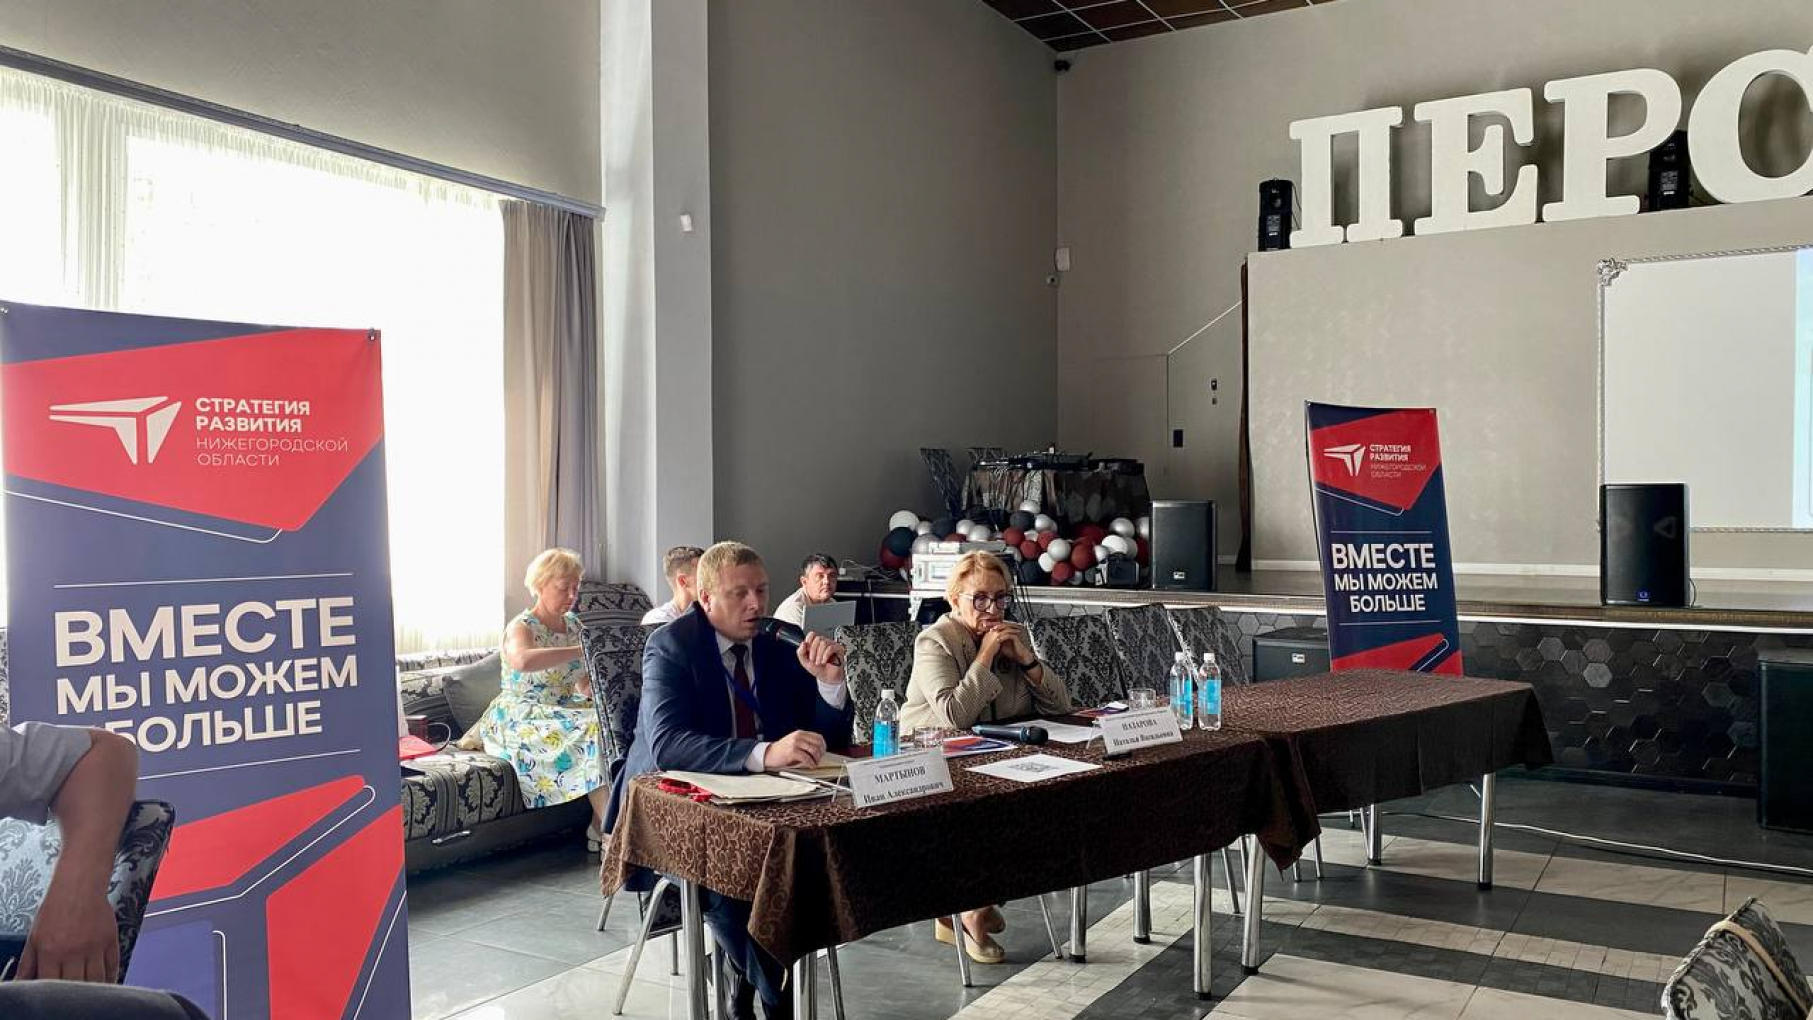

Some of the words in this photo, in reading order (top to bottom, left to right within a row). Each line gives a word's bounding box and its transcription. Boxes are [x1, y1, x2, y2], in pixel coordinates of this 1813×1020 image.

[195, 397, 310, 416] СТРАТЕГИЯ
[196, 417, 302, 433] РАЗВИТИЯ
[196, 436, 349, 453] НИЖЕГОРОДСКОЙ
[1370, 444, 1412, 453] СТРАТЕГИЯ
[197, 453, 280, 466] ОБЛАСТИ
[1370, 452, 1409, 461] РАЗВИТИЯ
[1331, 543, 1436, 569] ВМЕСТЕ
[1334, 573, 1364, 591] МЫ
[1368, 572, 1438, 590] МОЖЕМ
[1350, 594, 1426, 613] БОЛЬШЕ
[54, 597, 356, 667] ВМЕСТЕ
[57, 671, 151, 715] МЫ
[165, 655, 358, 705] МОЖЕМ
[874, 766, 926, 783] МАРТЫНОВ
[863, 793, 886, 804] Иван
[888, 781, 944, 798] Александрович
